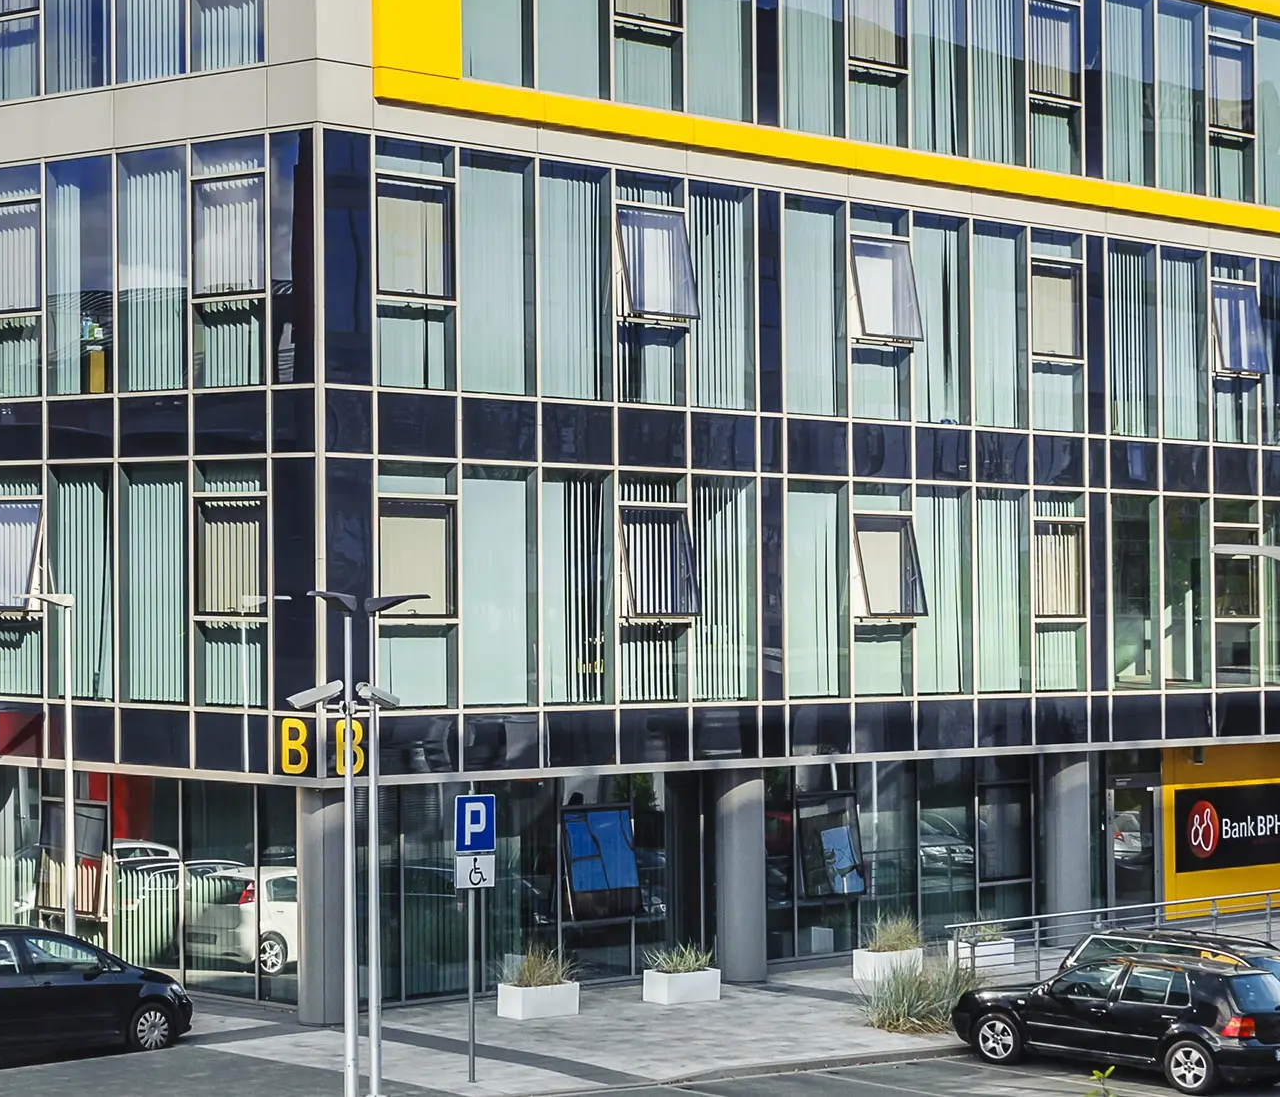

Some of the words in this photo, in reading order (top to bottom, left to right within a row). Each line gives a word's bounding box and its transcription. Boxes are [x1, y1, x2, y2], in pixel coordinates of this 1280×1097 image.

[281, 717, 308, 775] B
[335, 718, 365, 776] B
[464, 801, 487, 846] P
[1221, 815, 1256, 839] Bank
